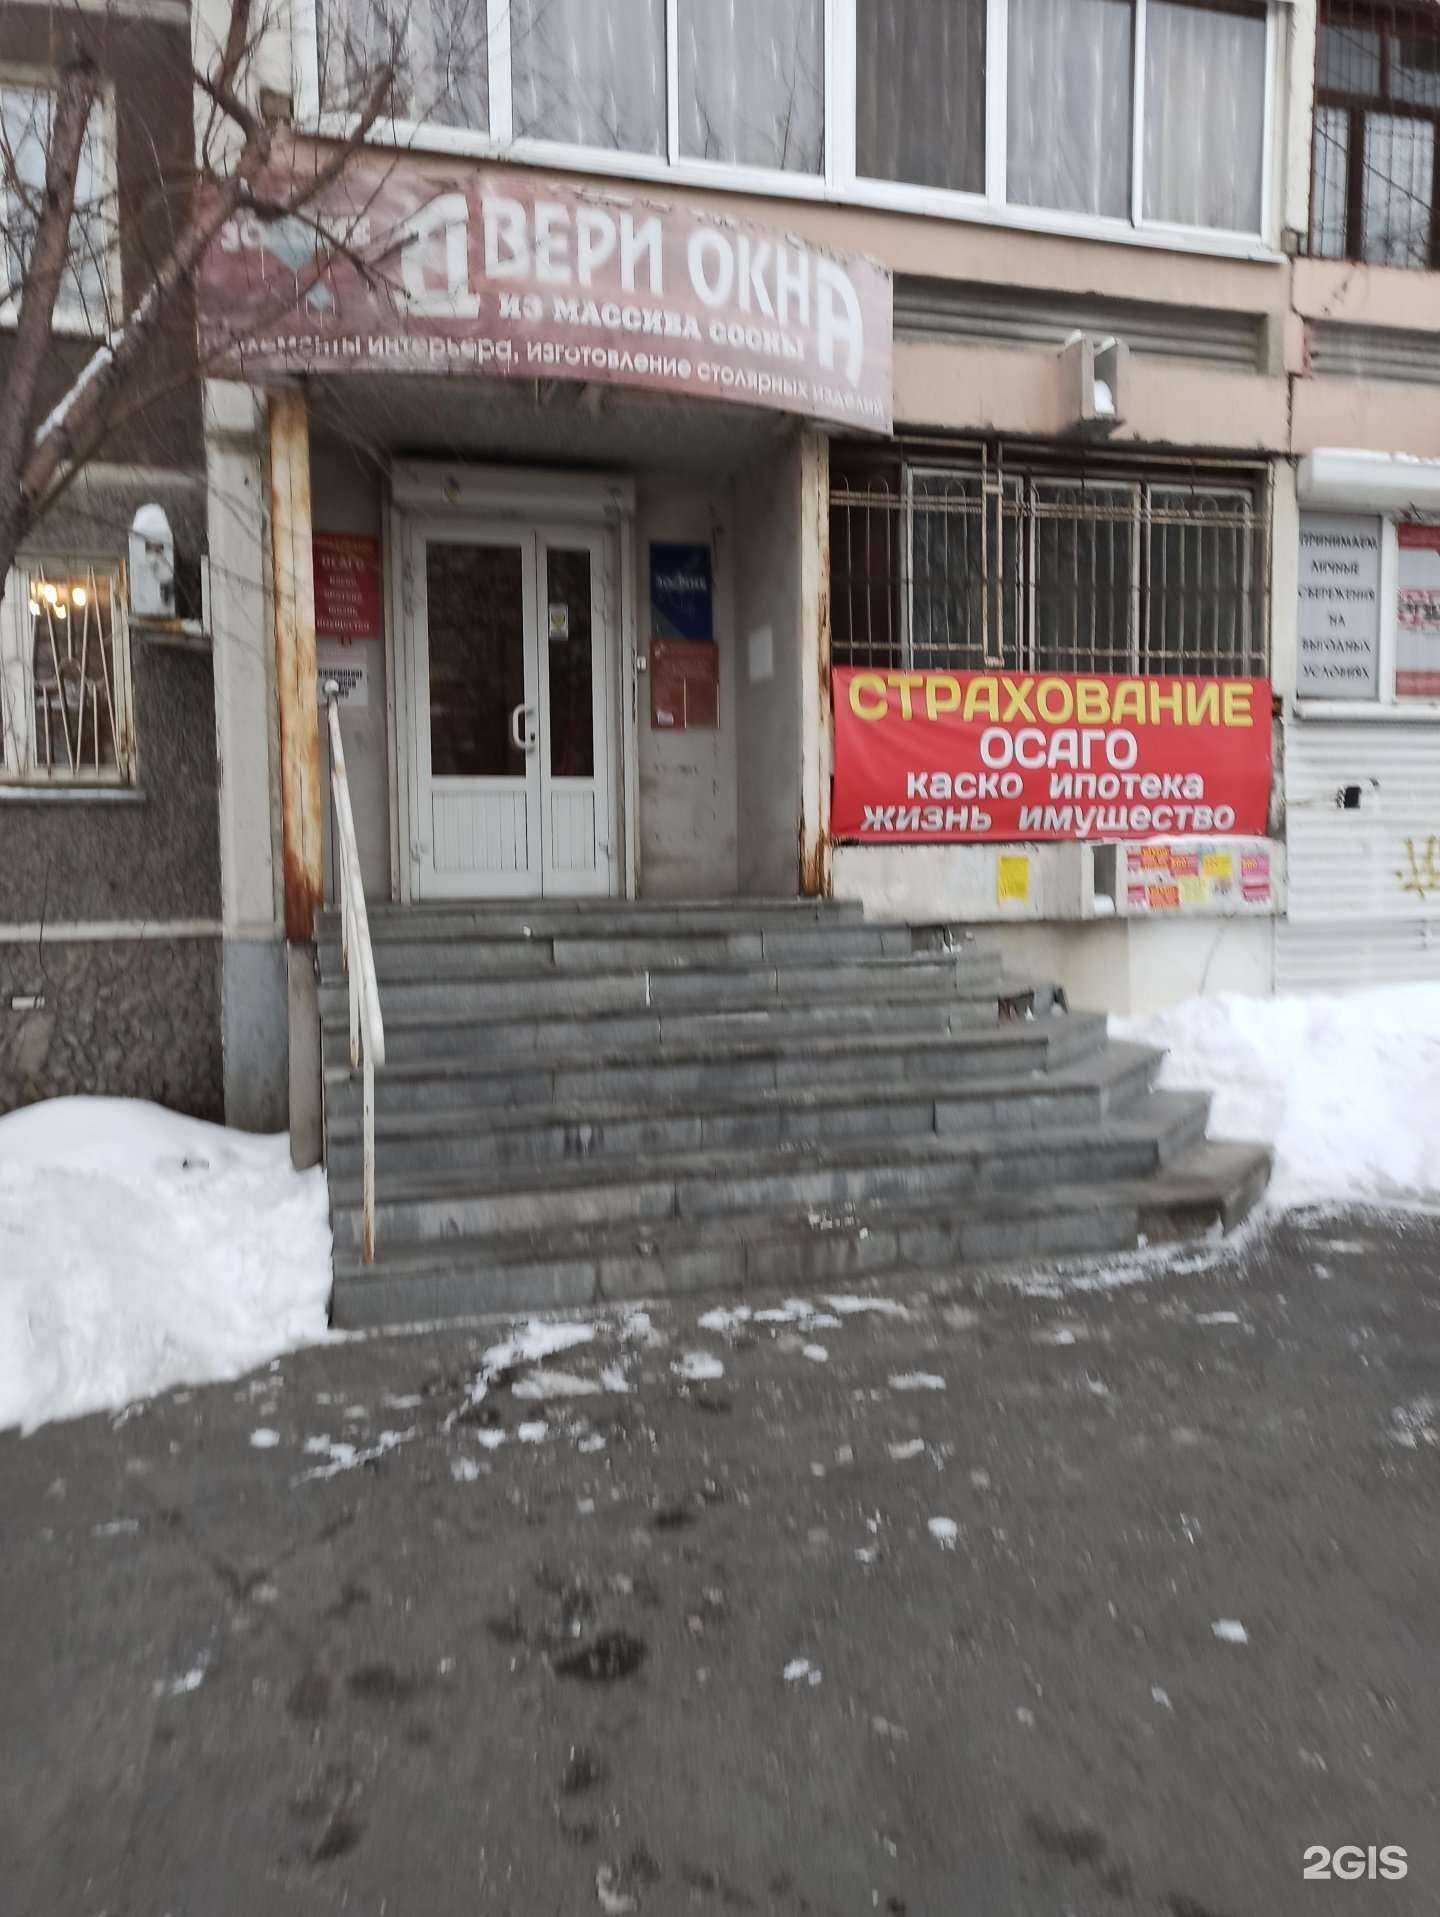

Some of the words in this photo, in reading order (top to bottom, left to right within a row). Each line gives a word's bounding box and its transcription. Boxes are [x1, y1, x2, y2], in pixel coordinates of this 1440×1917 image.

[394, 192, 665, 319] ДВЕРИ
[687, 227, 863, 388] ОКНА
[499, 293, 544, 321] ИЗ
[552, 295, 702, 343] МАССИВА
[708, 320, 806, 361] СОСНЫ
[527, 341, 692, 378] изготовление
[1328, 612, 1346, 627] НА
[848, 674, 1254, 726] СТРАХОВАНИЕ
[980, 727, 1138, 770] ОСАГО
[907, 772, 1024, 800] каско
[1049, 774, 1204, 800] ипотека
[860, 804, 992, 832] жизнь
[1018, 805, 1236, 836] имущество
